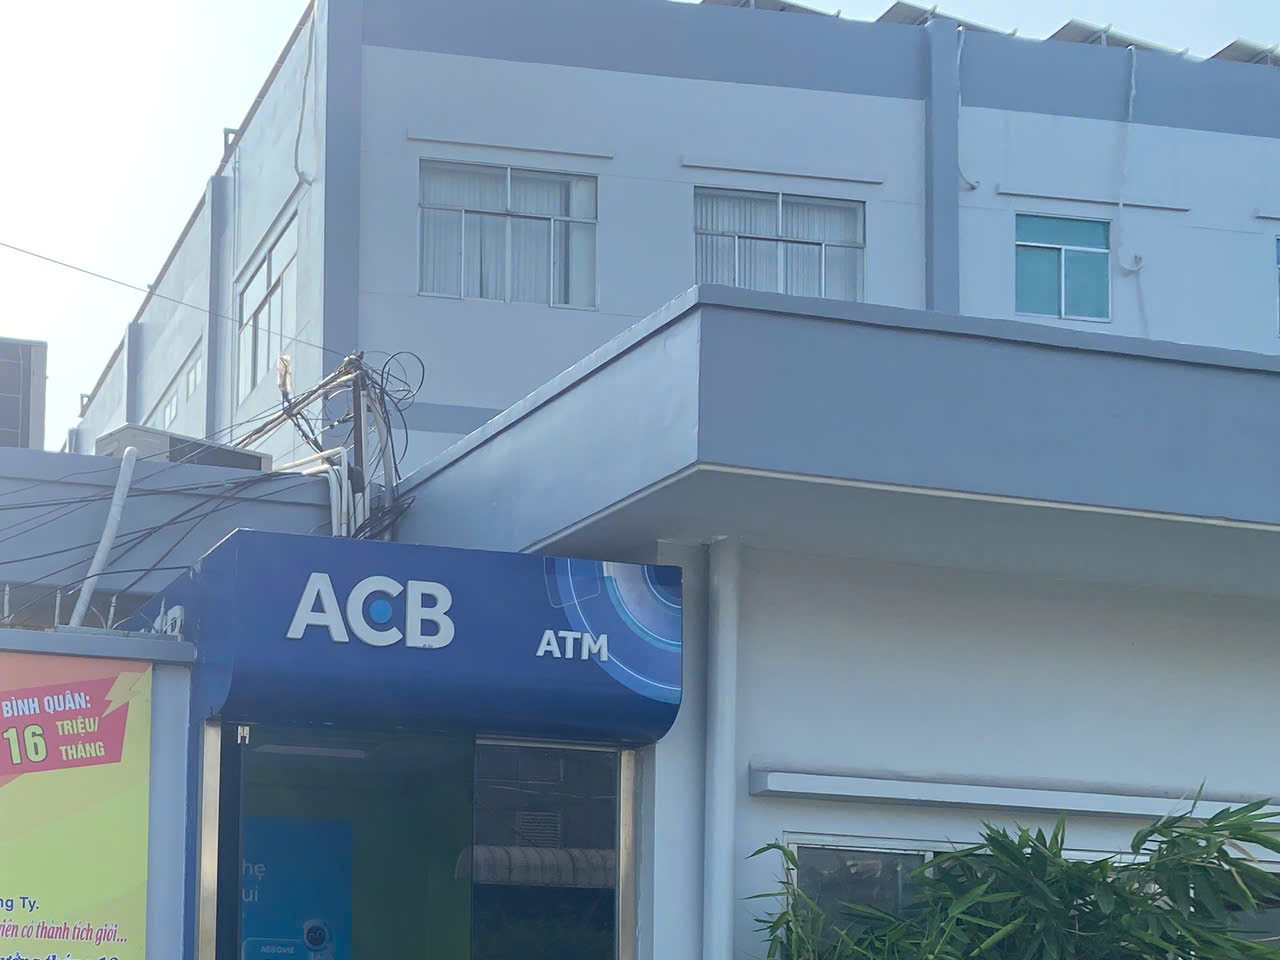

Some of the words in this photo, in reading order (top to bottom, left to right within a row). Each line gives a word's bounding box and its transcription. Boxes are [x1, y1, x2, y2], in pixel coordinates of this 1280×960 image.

[286, 572, 455, 648] ACB
[536, 629, 608, 662] ATM
[2, 697, 40, 717] BÌNH
[44, 691, 90, 714] QUÂN:
[56, 716, 99, 736] TRIỆU/
[2, 724, 48, 765] 16
[59, 741, 104, 761] THÁNG
[18, 896, 39, 912] Ty.
